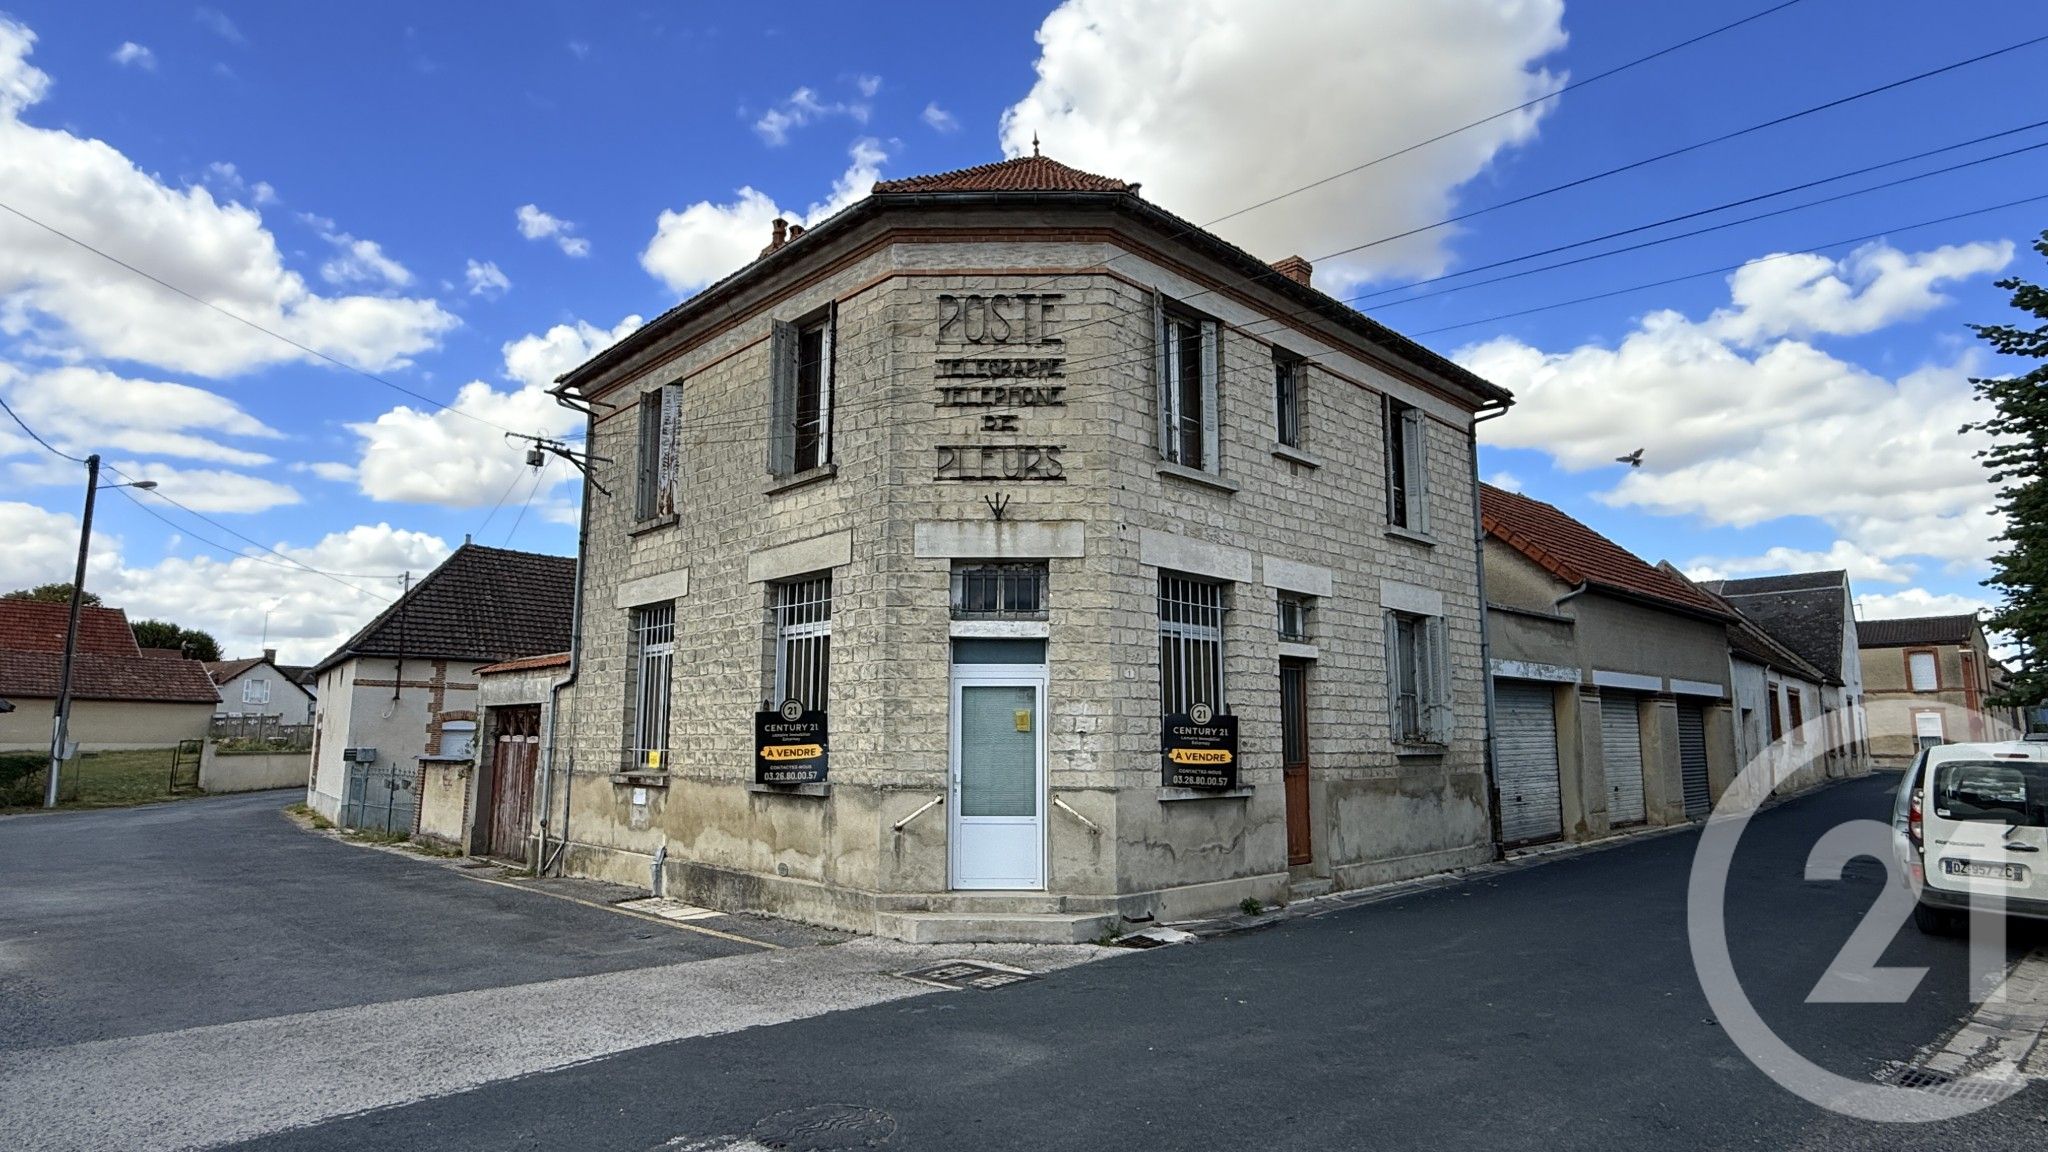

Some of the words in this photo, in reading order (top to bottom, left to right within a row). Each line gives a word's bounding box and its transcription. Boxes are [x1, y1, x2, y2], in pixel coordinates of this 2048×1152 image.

[937, 294, 1066, 344] POSTE
[935, 358, 1066, 378] TELEGRAPHE
[935, 387, 1066, 407] TELEPHONE
[981, 415, 1018, 431] DE
[934, 445, 1066, 480] PLEURS
[787, 707, 797, 716] 21
[1196, 710, 1206, 719] 21
[764, 723, 808, 732] CENTURY
[809, 723, 819, 731] 21
[1173, 726, 1217, 736] CENTURY
[1219, 728, 1229, 736] 21
[767, 747, 774, 757] À
[776, 748, 817, 757] VENDRE
[1175, 750, 1183, 760] À
[1185, 752, 1226, 762] VENDRE
[764, 771, 817, 781] 03.26.80.00.57
[1172, 775, 1228, 786] 03.26.80.00.57
